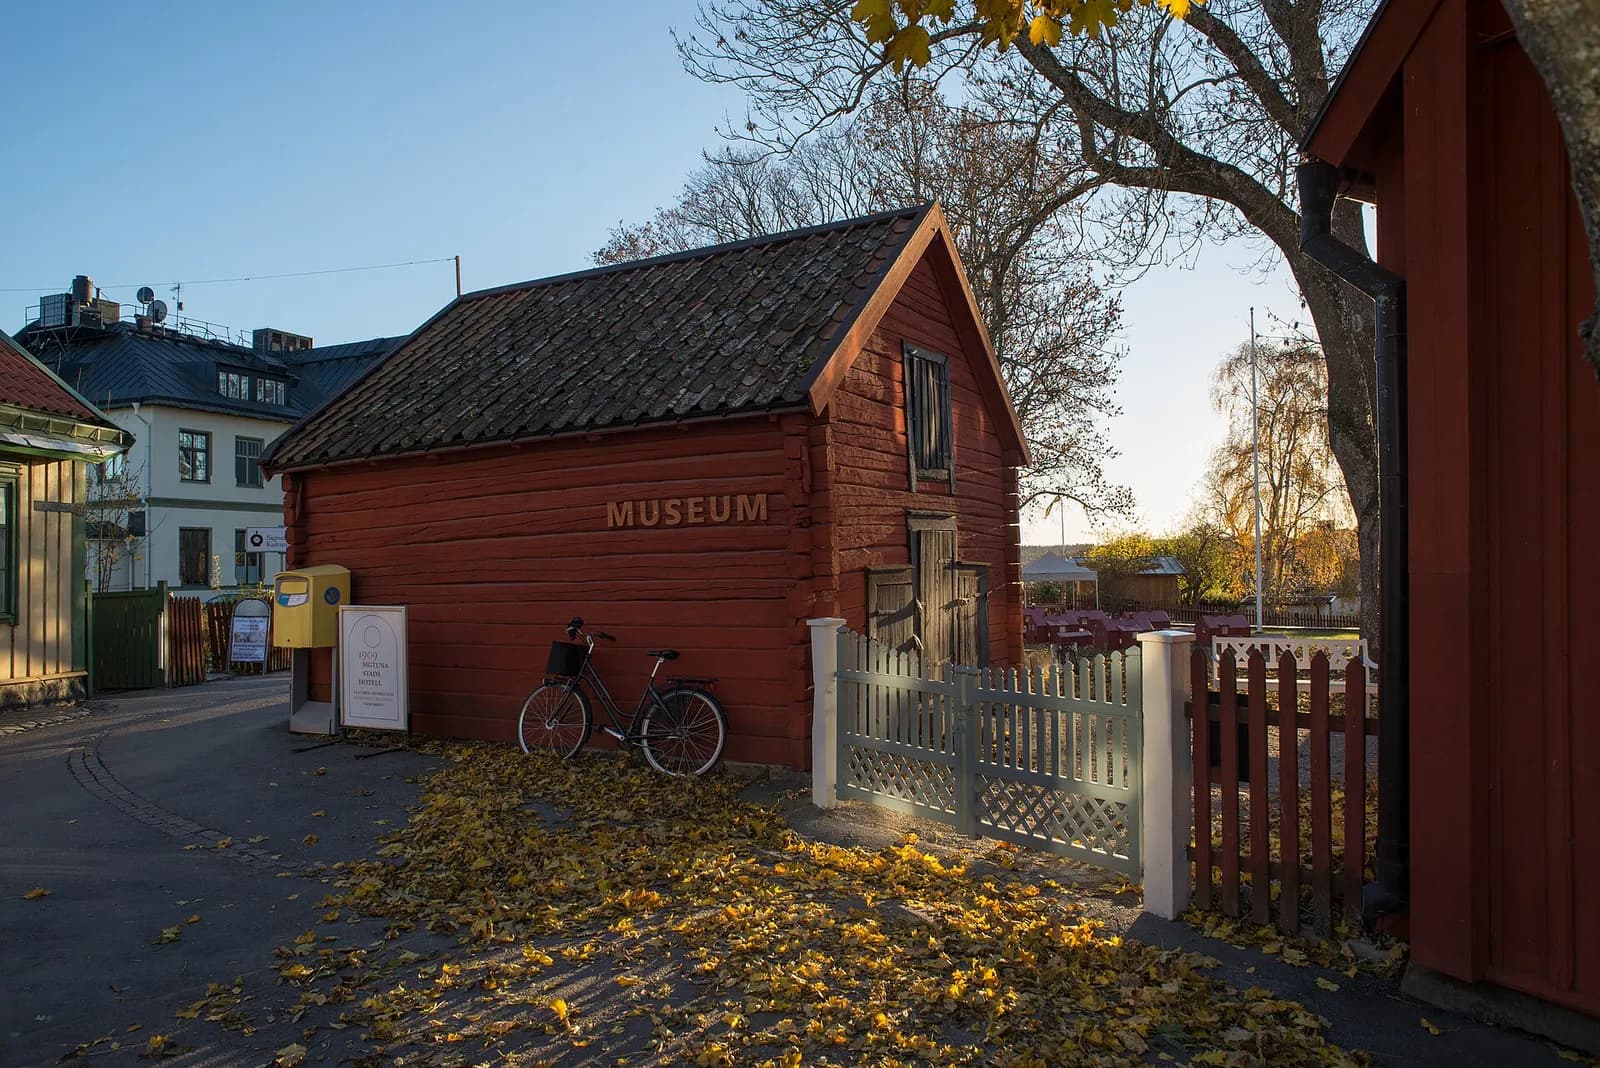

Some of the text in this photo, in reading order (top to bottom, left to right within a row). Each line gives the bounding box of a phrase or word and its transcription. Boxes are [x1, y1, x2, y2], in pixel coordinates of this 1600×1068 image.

[606, 493, 768, 528] MUSEUM
[362, 661, 389, 669] SIGTUNA
[358, 679, 382, 687] HOTELL
